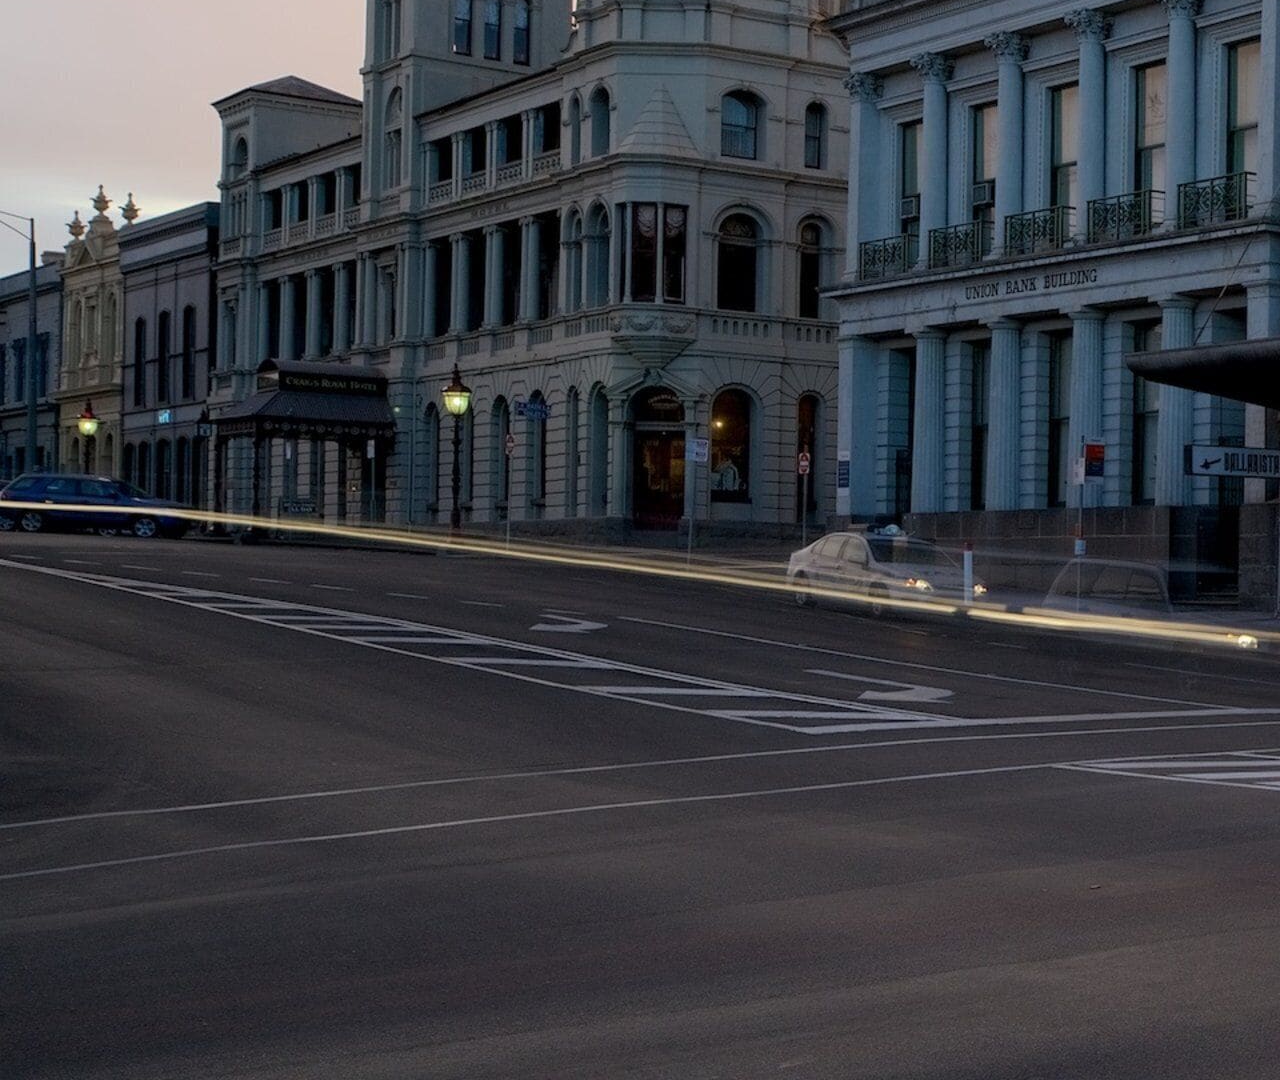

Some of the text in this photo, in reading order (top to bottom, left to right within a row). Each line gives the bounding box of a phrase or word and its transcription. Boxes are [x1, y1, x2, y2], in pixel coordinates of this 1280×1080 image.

[965, 269, 1097, 301] UNION BANK BUILDING
[1224, 453, 1280, 476] BALLARISTA
